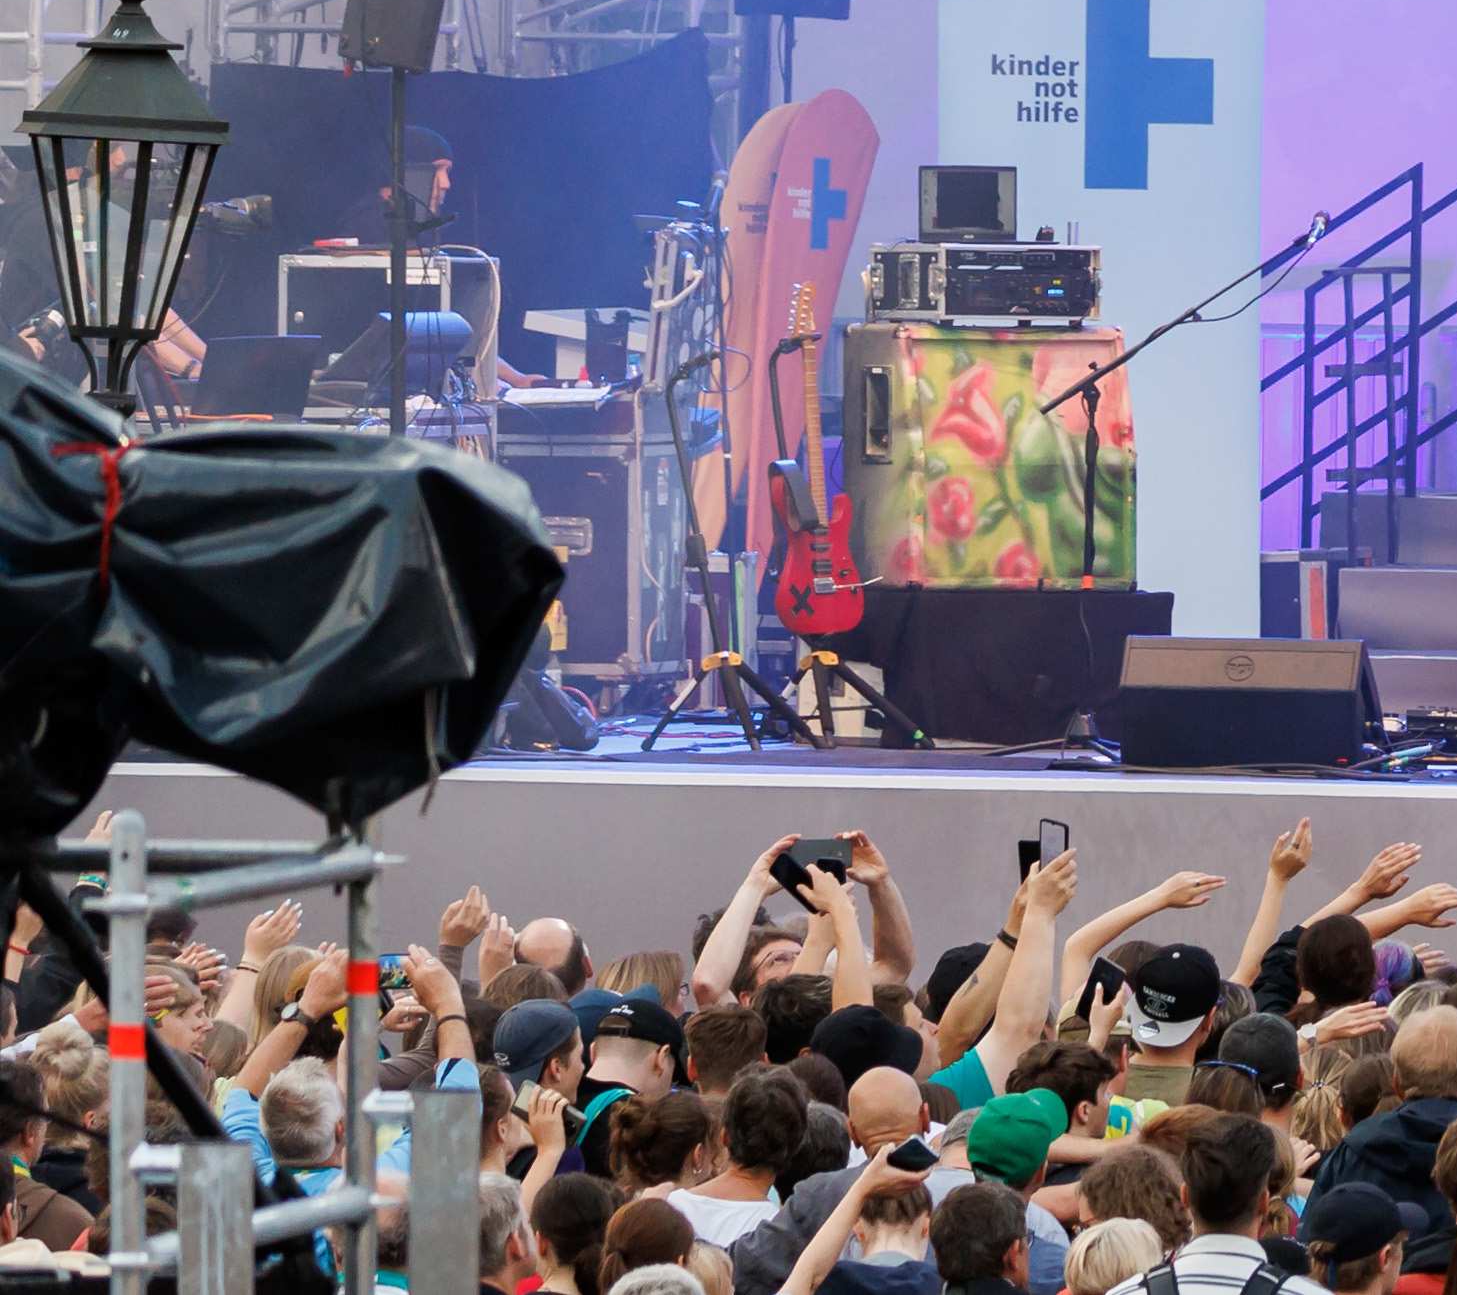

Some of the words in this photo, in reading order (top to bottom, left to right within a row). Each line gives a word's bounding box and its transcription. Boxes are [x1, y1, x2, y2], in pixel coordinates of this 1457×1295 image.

[991, 53, 1079, 76] kinder
[1035, 79, 1078, 98] not
[1017, 101, 1079, 123] hilfe
